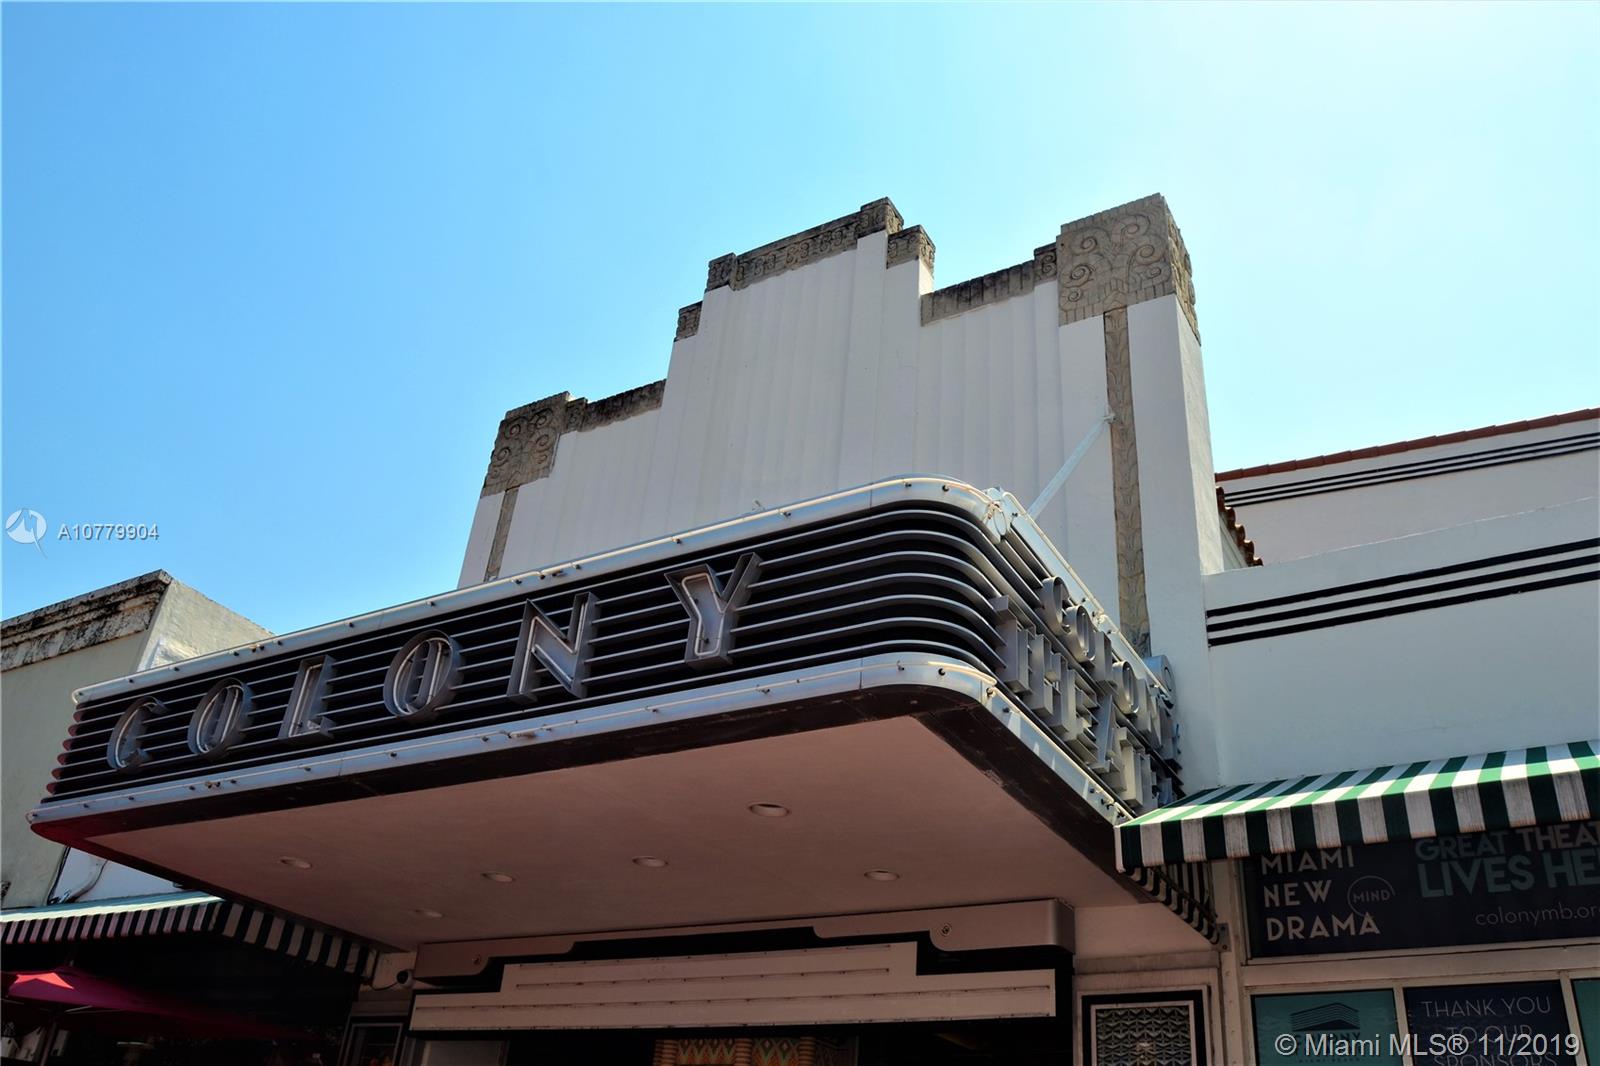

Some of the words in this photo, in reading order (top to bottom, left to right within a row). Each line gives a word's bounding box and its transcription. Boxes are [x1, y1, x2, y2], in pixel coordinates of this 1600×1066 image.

[106, 552, 763, 772] COLONY
[1414, 833, 1508, 861] GREAT
[1260, 847, 1354, 876] MIAMI
[1417, 855, 1536, 898] LIVES
[1543, 846, 1600, 888] HE
[1261, 880, 1332, 908] NEW
[1353, 888, 1390, 903] MIND
[1266, 912, 1381, 942] DRAMA
[1475, 900, 1600, 927] colonymb.or
[1420, 998, 1497, 1018] THANK
[1501, 995, 1551, 1014] YOU
